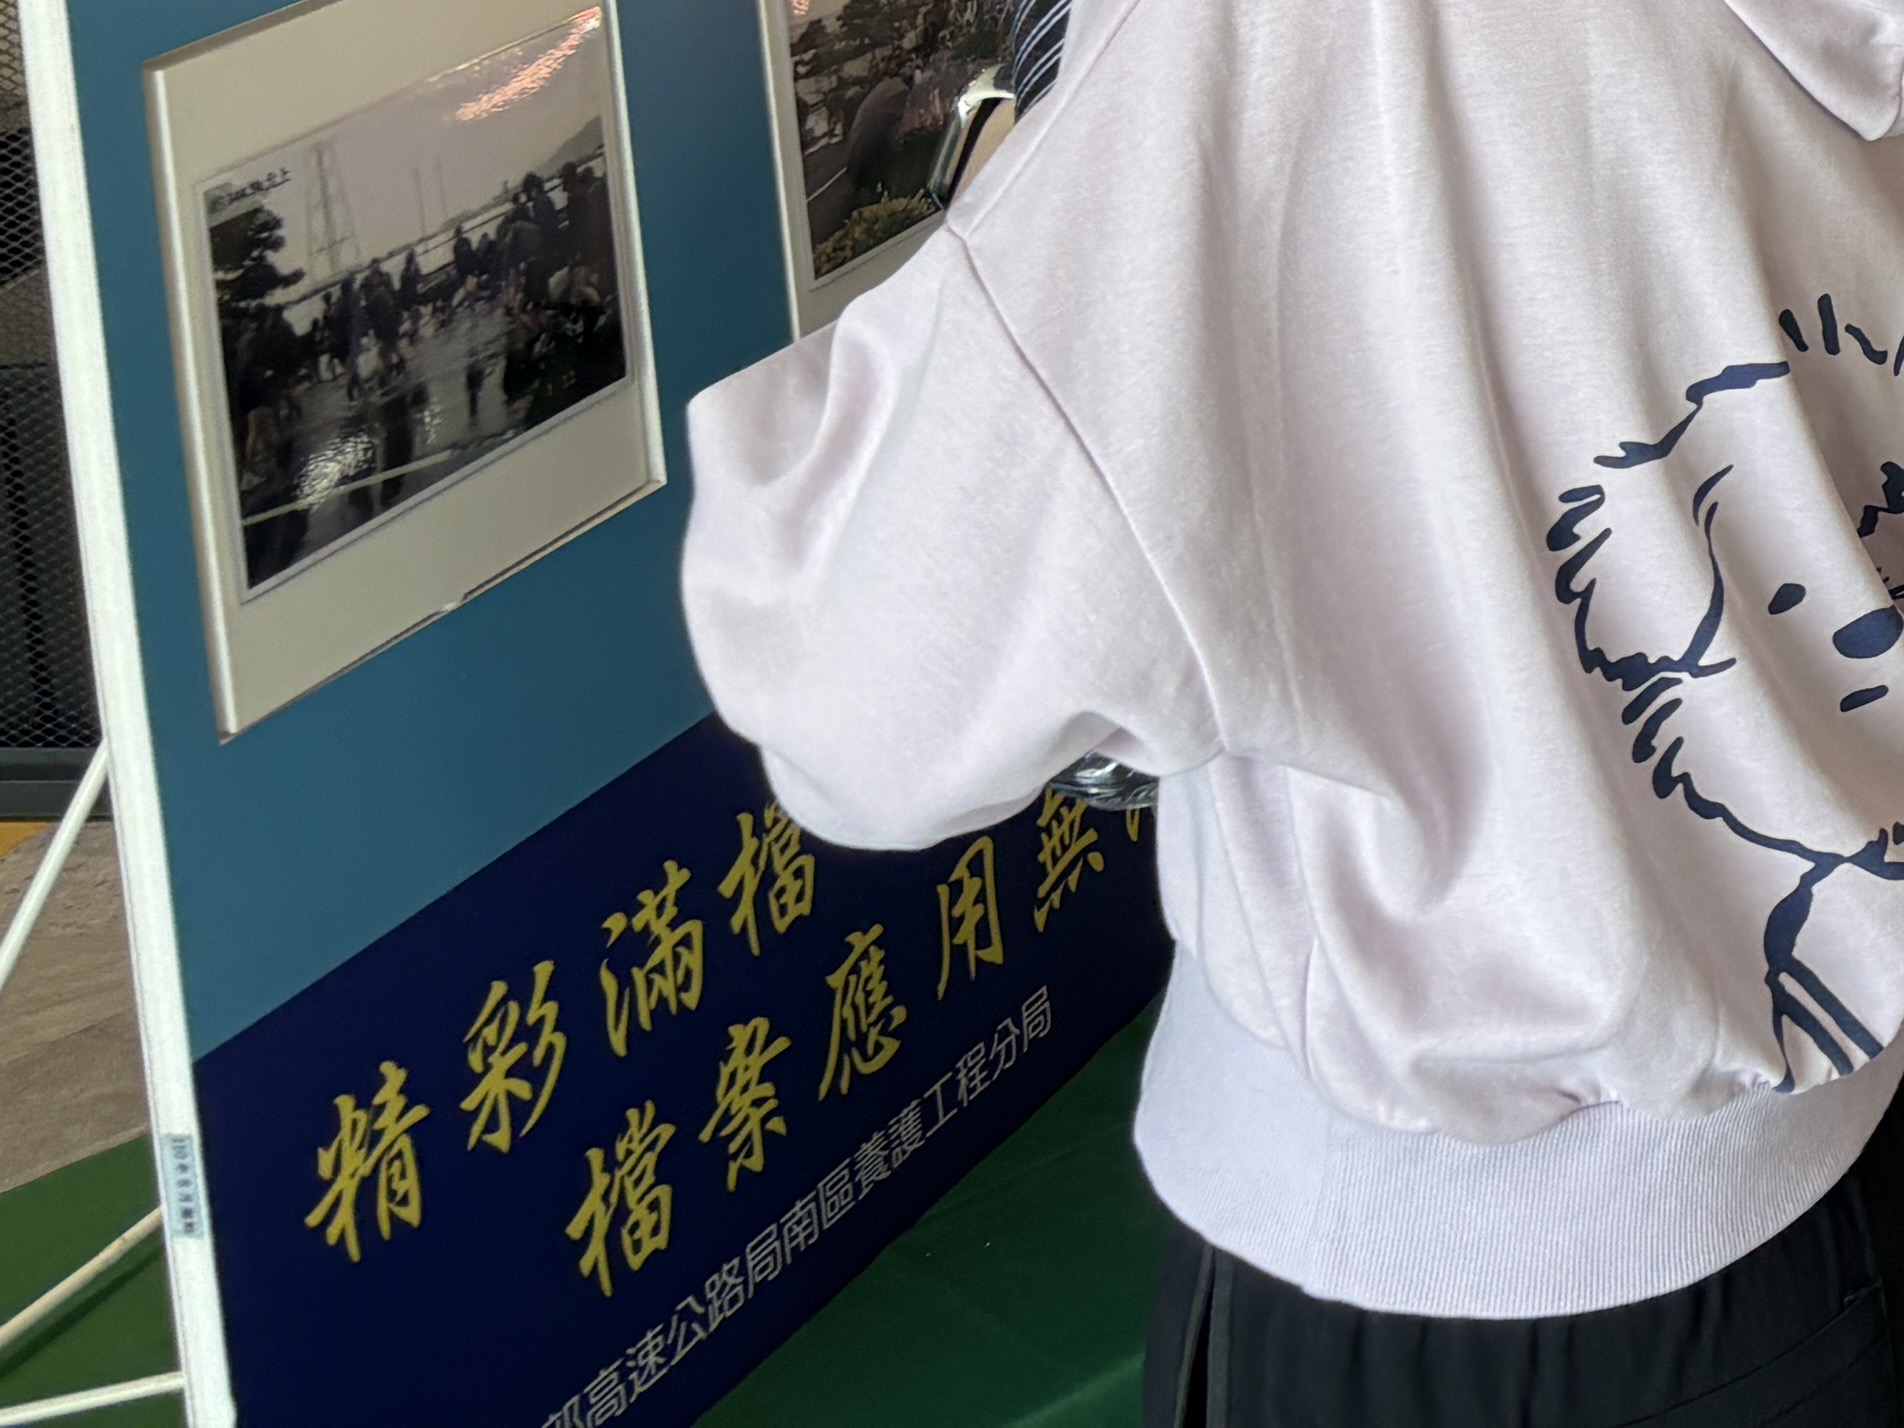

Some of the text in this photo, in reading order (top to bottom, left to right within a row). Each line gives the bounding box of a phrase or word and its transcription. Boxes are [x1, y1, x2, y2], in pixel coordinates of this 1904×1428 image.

[305, 802, 816, 1263] 精彩滿檔
[565, 790, 1142, 1296] 檔案應用無
